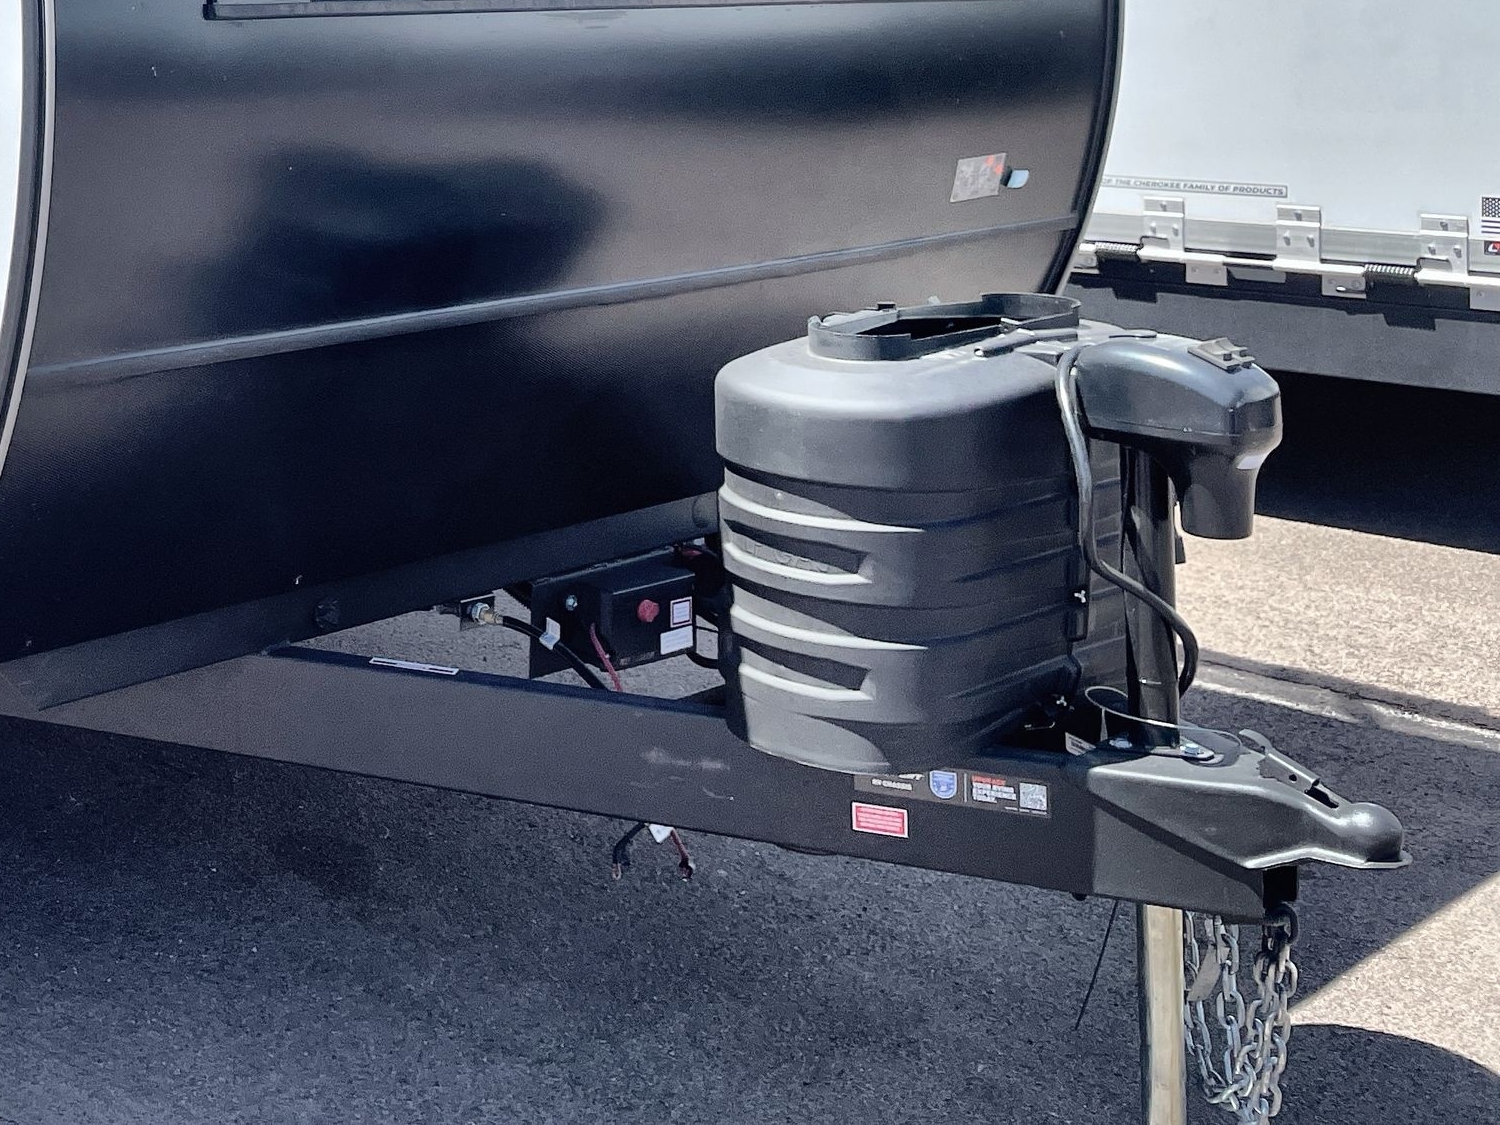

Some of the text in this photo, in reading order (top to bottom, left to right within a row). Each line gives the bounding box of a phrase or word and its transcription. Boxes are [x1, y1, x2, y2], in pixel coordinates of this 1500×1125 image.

[1134, 179, 1181, 189] CHEROKEE
[1183, 183, 1215, 192] FAMILY
[1218, 184, 1230, 192] OF
[1233, 186, 1284, 196] PRODUCTS
